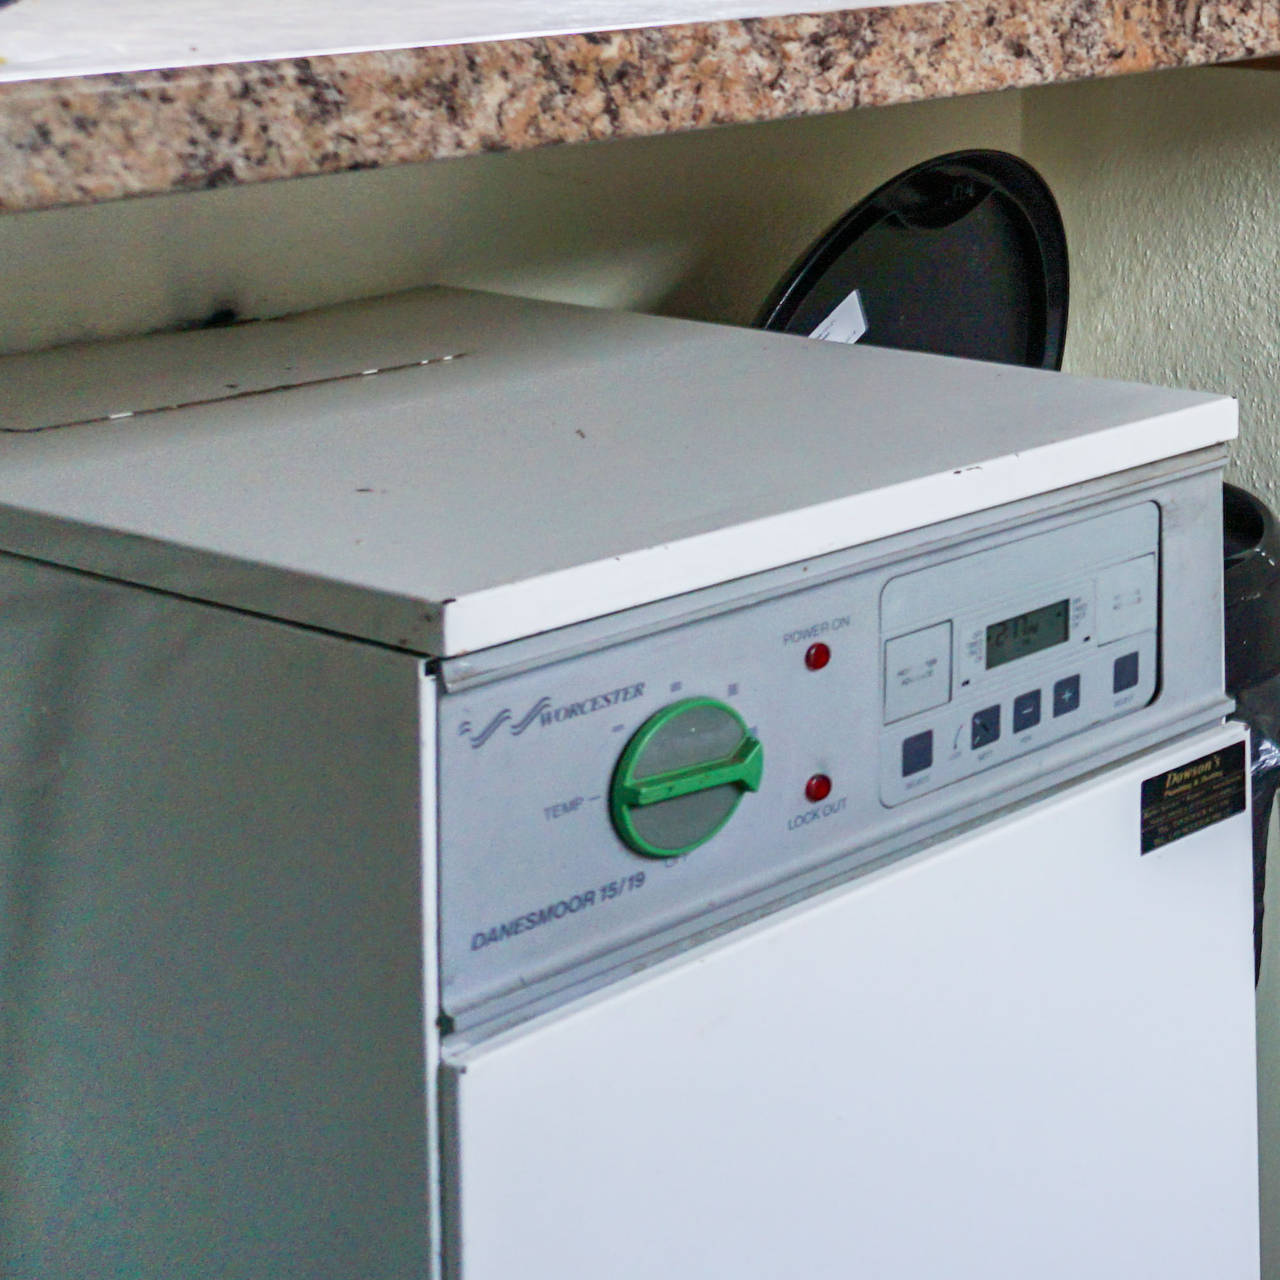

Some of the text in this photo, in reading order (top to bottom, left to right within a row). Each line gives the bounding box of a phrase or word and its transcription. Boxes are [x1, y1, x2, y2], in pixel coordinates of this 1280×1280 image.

[783, 615, 851, 646] POWER ON
[539, 681, 646, 728] WORCESTER
[543, 795, 583, 822] TEMP
[787, 797, 848, 831] LOCK OUT
[470, 870, 646, 952] DANESMOOR 15/19
